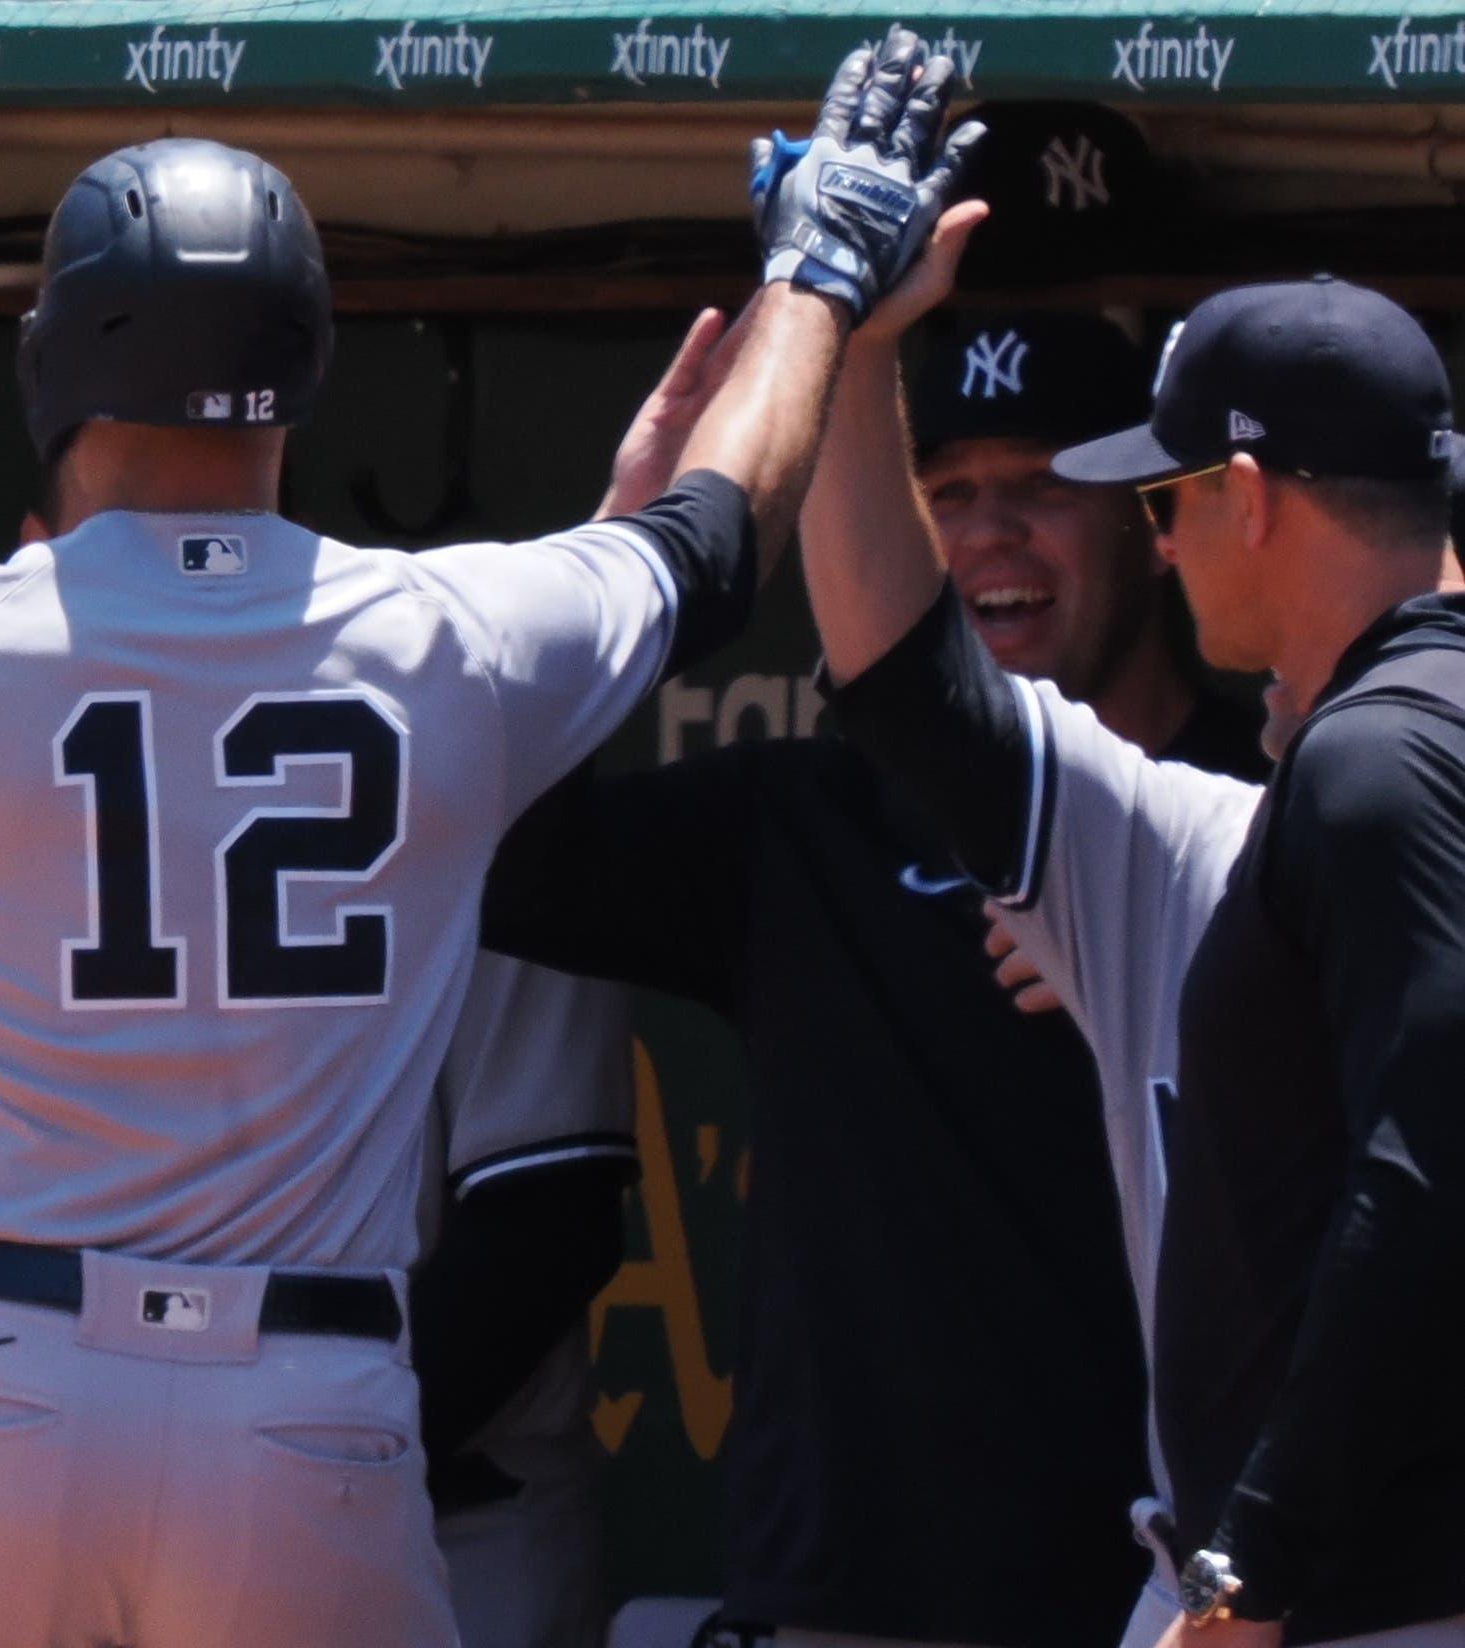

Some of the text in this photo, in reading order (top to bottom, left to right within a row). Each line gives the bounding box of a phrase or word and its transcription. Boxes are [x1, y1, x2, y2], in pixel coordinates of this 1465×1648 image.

[124, 26, 246, 93] xfinity
[375, 21, 494, 90] xfinity
[610, 19, 730, 88] xfinity
[1112, 22, 1234, 91] xfinity
[961, 329, 1029, 398] NY
[245, 388, 275, 421] 12
[51, 687, 412, 1011] 12
